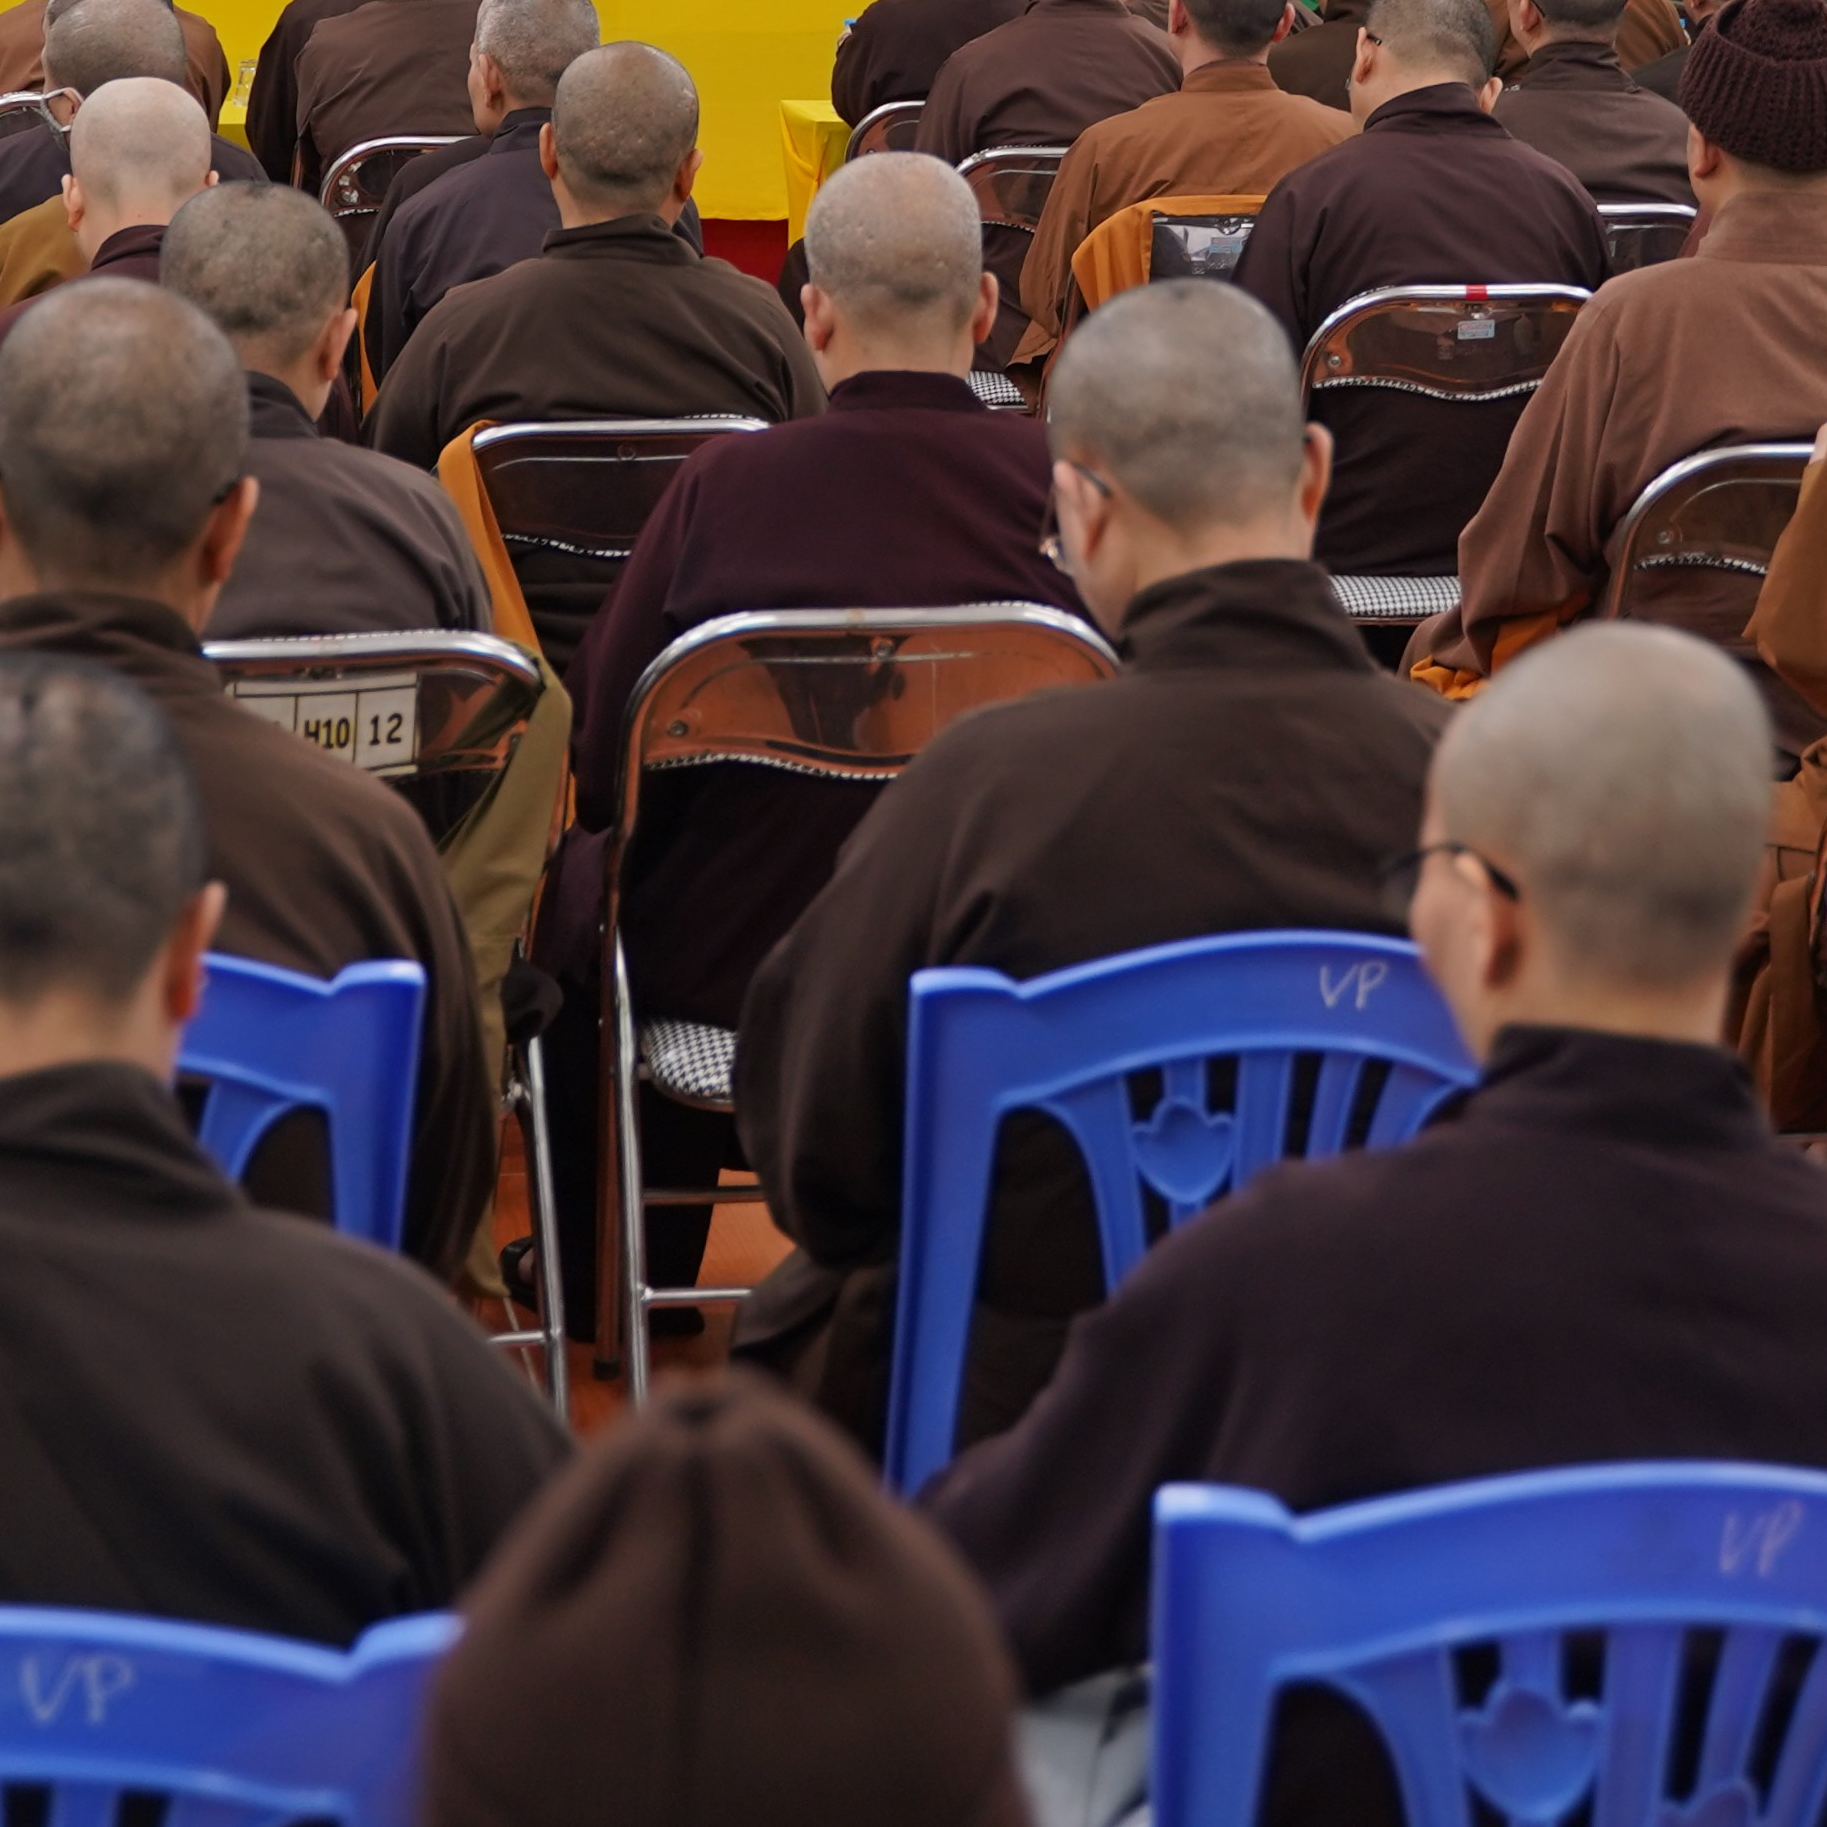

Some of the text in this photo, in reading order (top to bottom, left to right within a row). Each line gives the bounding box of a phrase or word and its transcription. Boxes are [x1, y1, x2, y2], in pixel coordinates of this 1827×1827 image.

[369, 713, 403, 746] 12
[1319, 960, 1387, 1009] VP
[21, 1653, 134, 1727] VP
